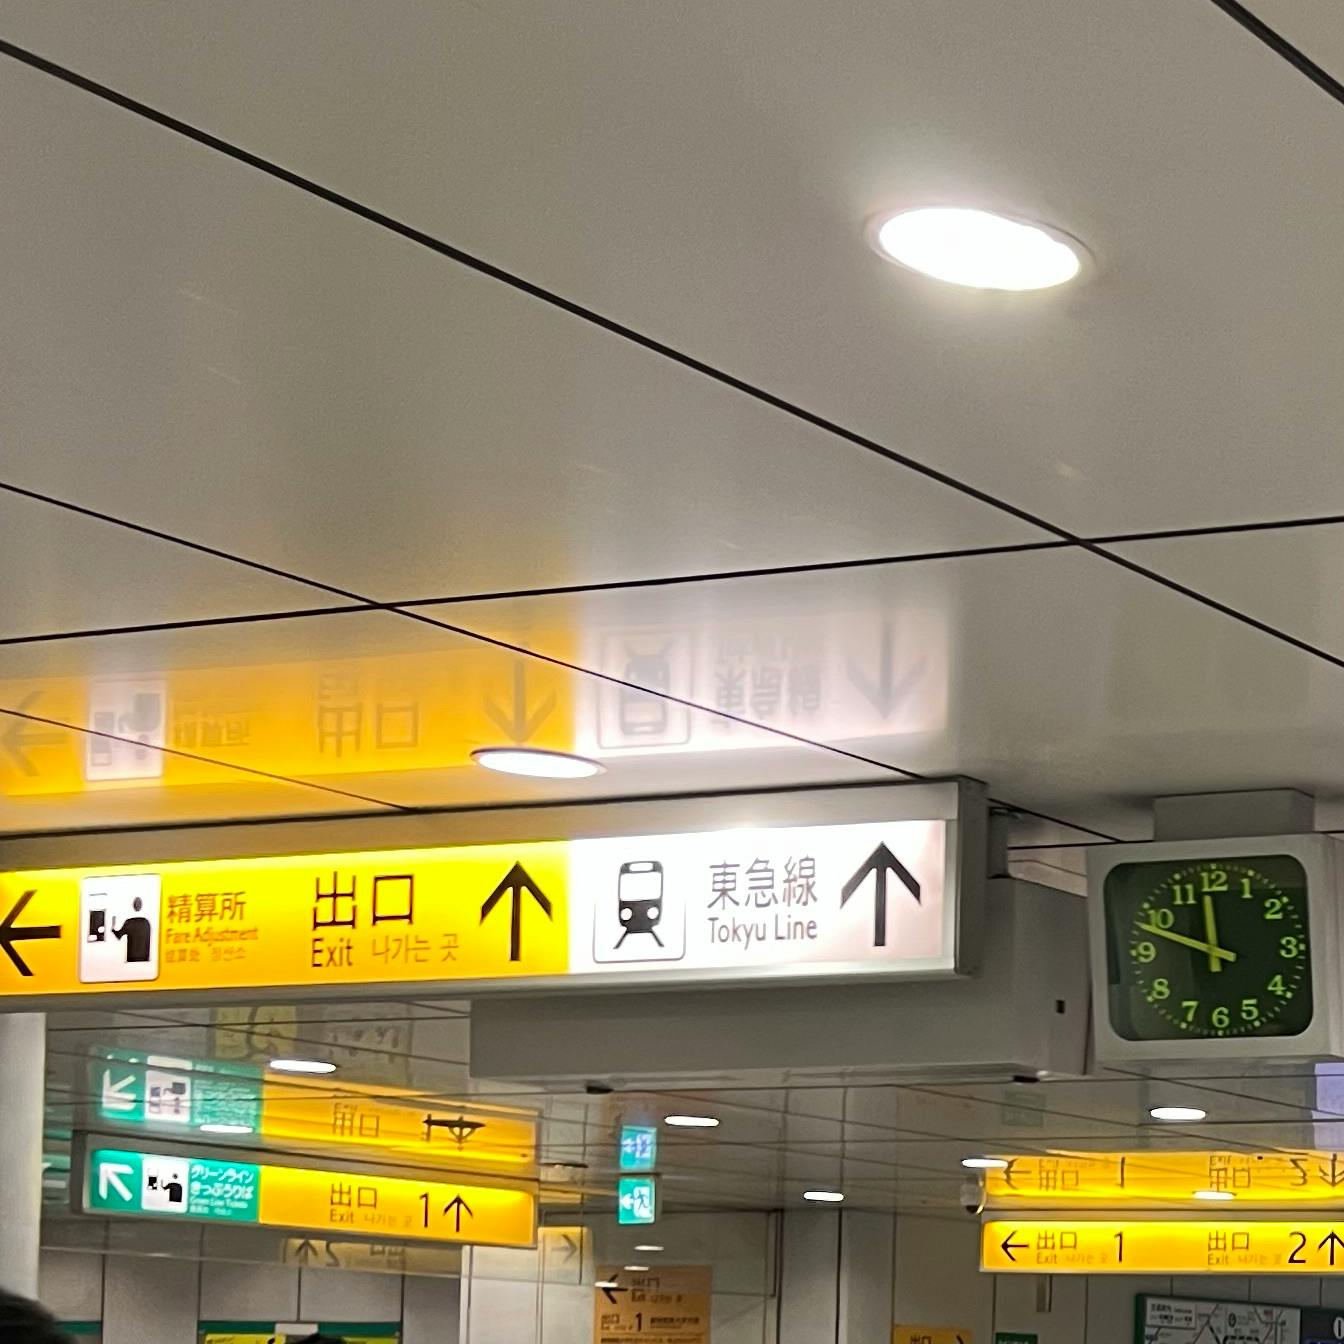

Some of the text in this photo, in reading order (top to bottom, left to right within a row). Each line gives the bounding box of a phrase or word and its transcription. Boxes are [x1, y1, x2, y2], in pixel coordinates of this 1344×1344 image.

[707, 854, 818, 911] 東急線
[1200, 870, 1229, 892] 12
[1241, 878, 1253, 899] 1
[312, 869, 415, 931] 出口
[1172, 883, 1197, 905] 11
[166, 890, 248, 924] 精算所
[1264, 898, 1284, 920] 2
[1149, 908, 1175, 929] 10
[707, 913, 819, 951] Tokyu Line
[311, 936, 354, 968] Exit
[371, 932, 460, 965] 나가는 곳
[1136, 941, 1157, 963] 9
[1280, 936, 1299, 958] 3
[1151, 978, 1171, 1000] 8
[1267, 973, 1287, 996] 4
[1181, 1000, 1199, 1023] 7
[1211, 1006, 1230, 1029] 6
[1241, 998, 1259, 1020] 5
[191, 1163, 254, 1184] グリーンライン
[329, 1181, 430, 1229] 出口 1
[329, 1209, 355, 1224] Exit
[1036, 1230, 1124, 1263] 出口 1
[1208, 1231, 1307, 1265] 出口 2
[1036, 1252, 1058, 1265] Exit
[1208, 1253, 1230, 1266] Exit
[635, 1312, 643, 1332] 1
